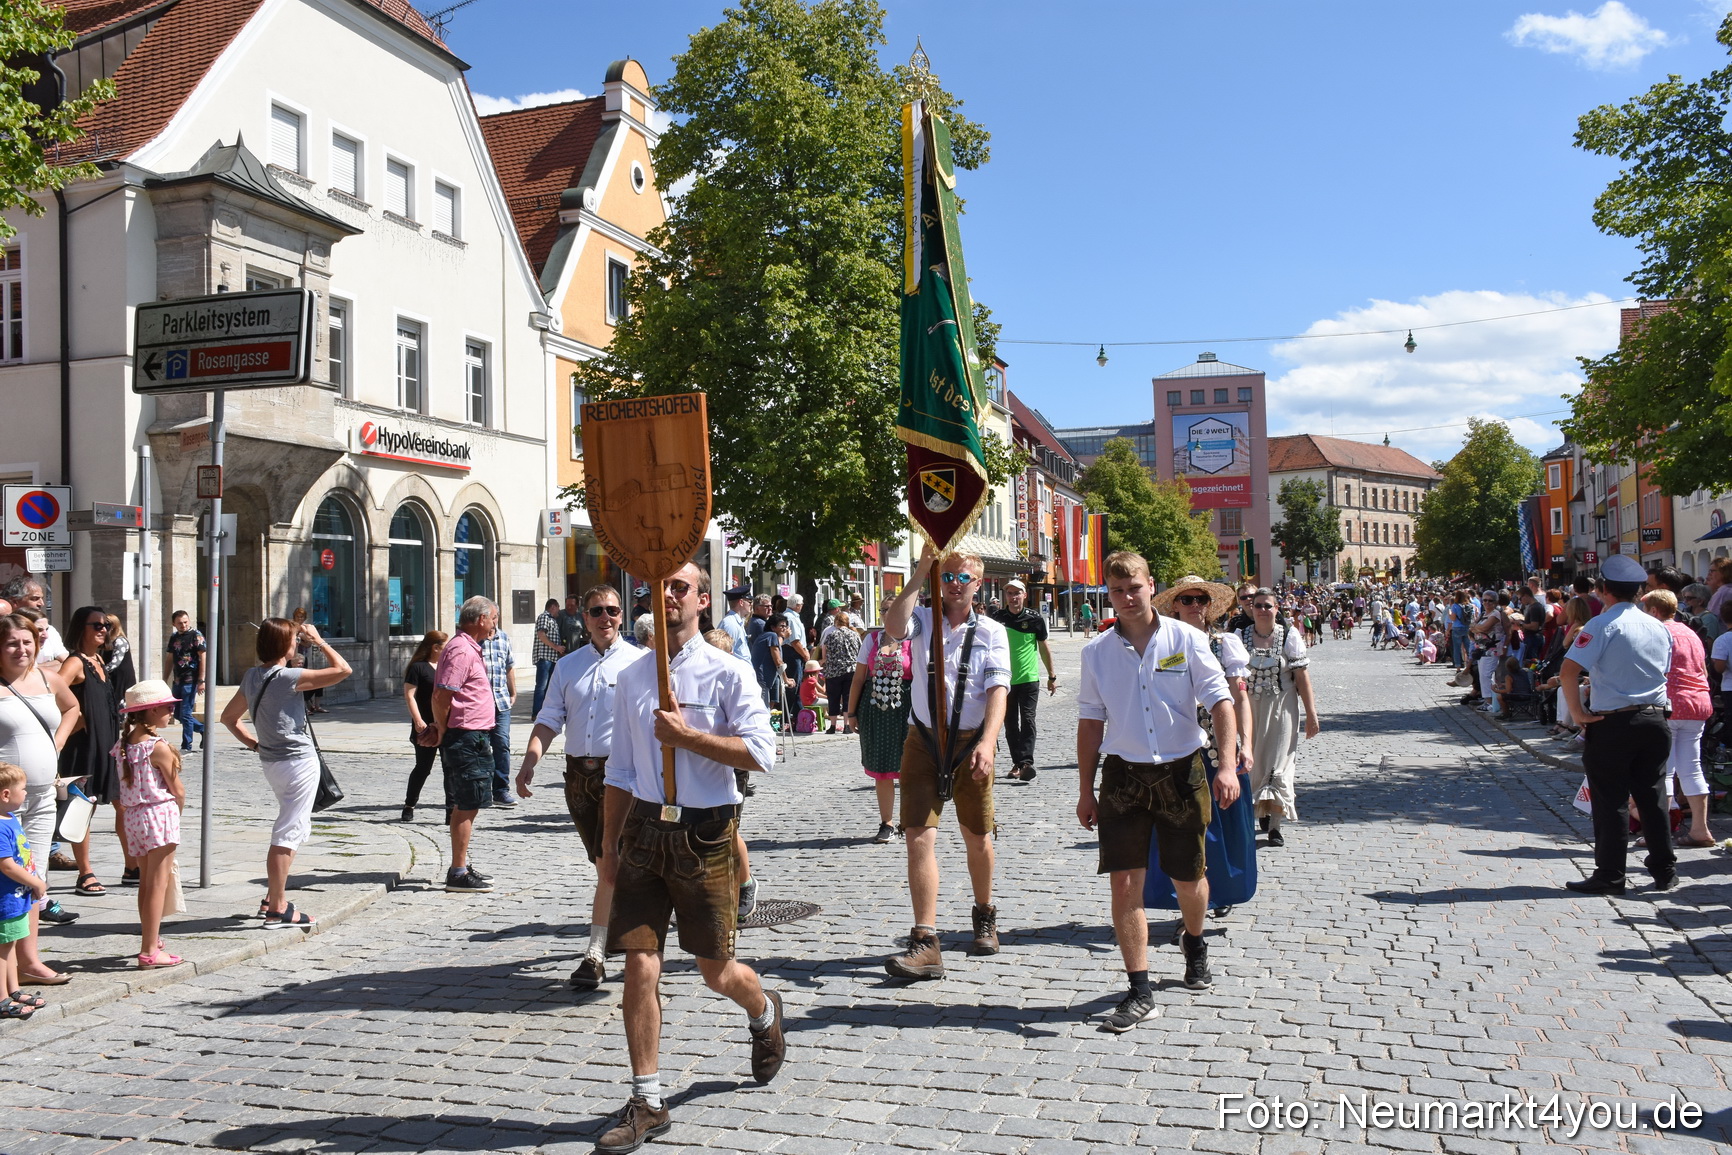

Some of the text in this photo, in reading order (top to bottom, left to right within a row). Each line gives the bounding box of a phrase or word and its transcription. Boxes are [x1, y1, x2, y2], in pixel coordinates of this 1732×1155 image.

[162, 306, 270, 335] Parkleitsystem
[198, 351, 269, 372] Rosengasse
[586, 395, 699, 423] REICHERTSHOFEN
[182, 431, 210, 447] Rosengass
[378, 425, 471, 460] HypoVereinsbank
[1184, 483, 1244, 495] usgezeichnet!
[587, 474, 632, 568] Schützenverein
[672, 466, 706, 564] Jägerwiesl
[21, 532, 55, 542] ZONE
[33, 551, 67, 559] Bewohner
